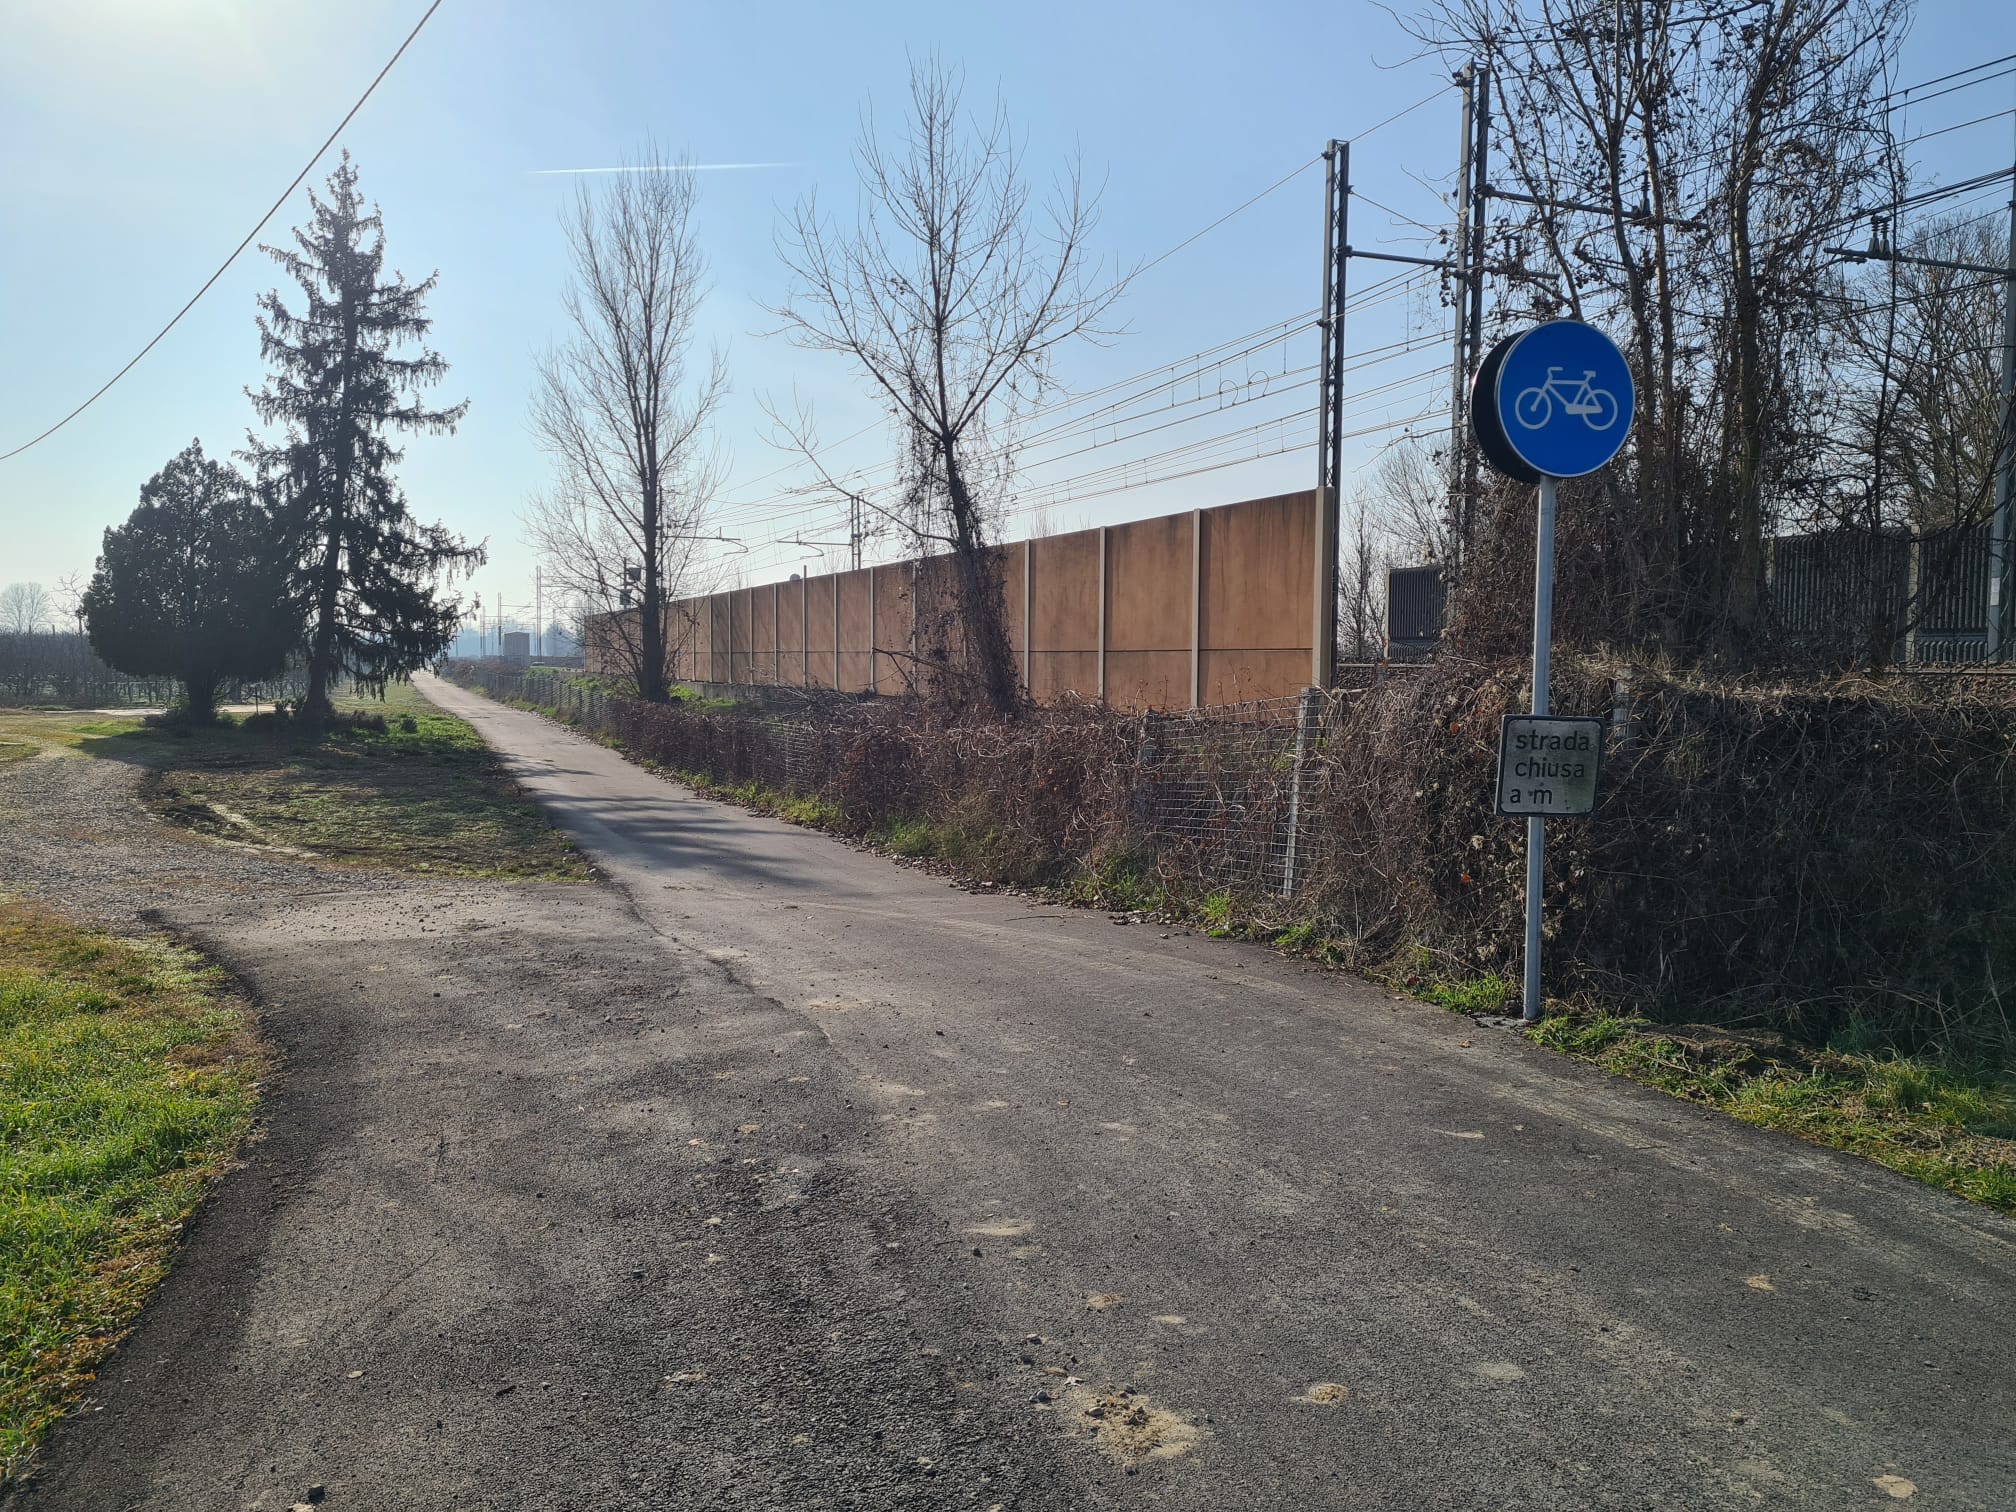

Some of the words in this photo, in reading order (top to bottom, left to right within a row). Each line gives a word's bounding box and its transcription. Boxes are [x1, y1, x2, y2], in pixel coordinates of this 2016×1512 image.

[1515, 729, 1590, 751] strada
[1515, 756, 1585, 778] chiusa
[1509, 788, 1521, 804] a
